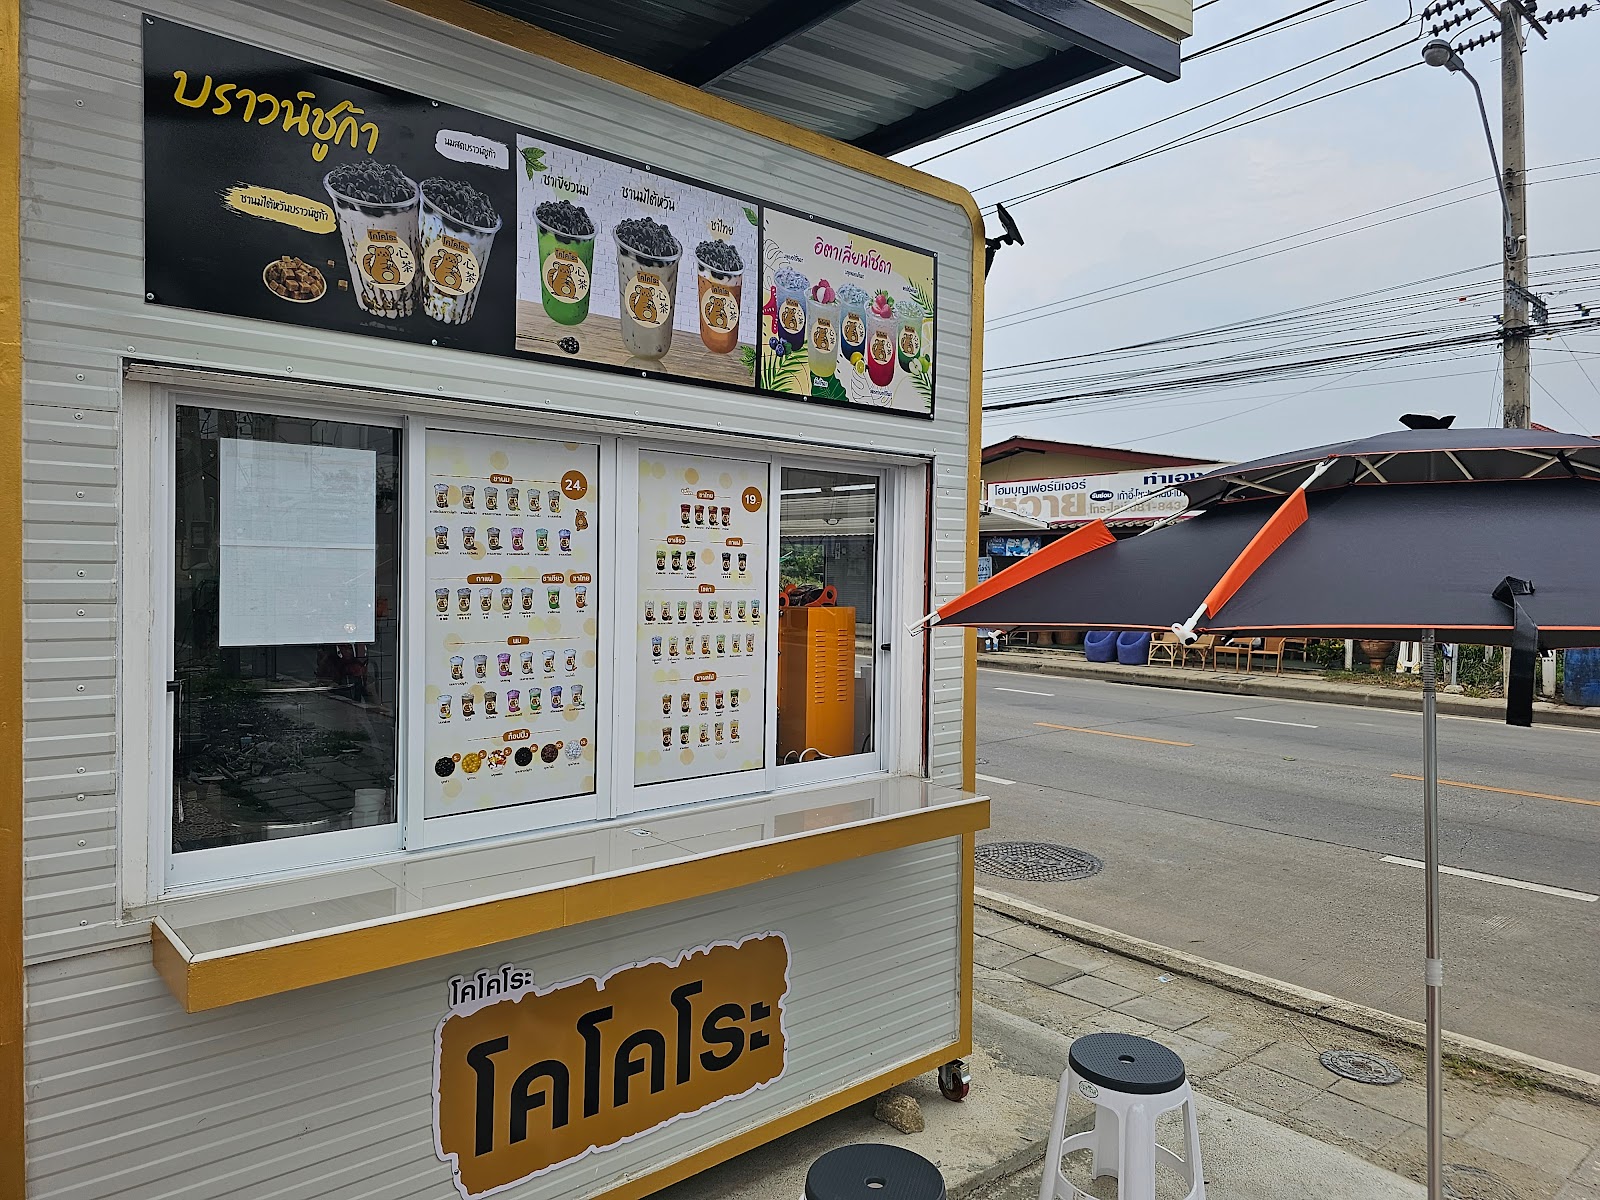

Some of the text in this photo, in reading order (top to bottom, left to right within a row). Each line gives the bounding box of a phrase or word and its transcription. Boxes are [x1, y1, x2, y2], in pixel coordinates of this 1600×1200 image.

[173, 70, 379, 162] บราวน์ชูก้า
[543, 174, 589, 196] ชาเขียวนม
[621, 186, 675, 211] ชานมไต้หวัน
[711, 219, 734, 235] ชาไทย
[451, 966, 532, 1006] โคโคโระ
[466, 980, 771, 1158] โคโคโระ
